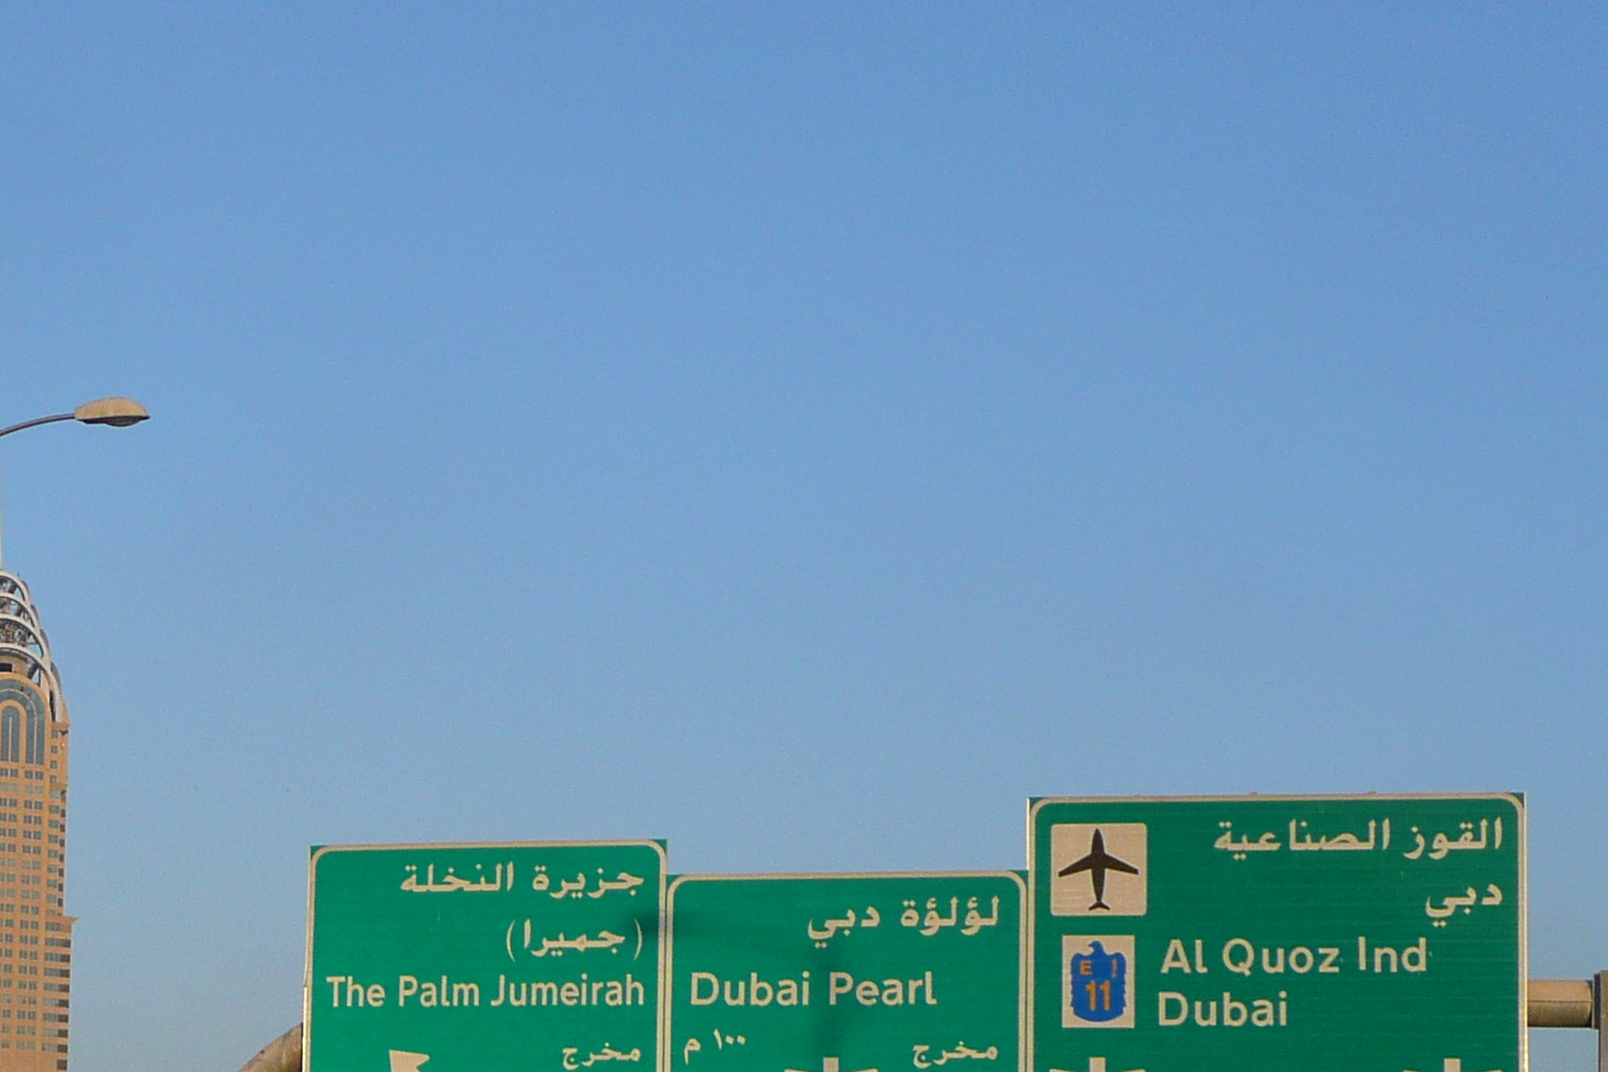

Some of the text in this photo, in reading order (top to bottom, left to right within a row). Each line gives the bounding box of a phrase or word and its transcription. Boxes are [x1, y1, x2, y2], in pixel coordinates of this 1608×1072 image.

[1214, 817, 1503, 860] القوز الصناعية
[400, 861, 645, 899] جزيرة النخلة
[807, 895, 1000, 949] لؤلؤة دبي
[1425, 883, 1503, 928] دبي
[506, 919, 643, 963] (جميرا)
[1160, 936, 1428, 977] Al Quoz Ind
[1080, 960, 1093, 976] E
[326, 973, 645, 1008] The Palm Jumeirah
[690, 970, 938, 1007] Dubai Pearl
[1086, 981, 1110, 1011] 11
[1158, 990, 1287, 1027] Dubai
[562, 1042, 641, 1071] مخرج
[683, 1038, 702, 1065] م
[913, 1041, 998, 1069] مخرج
